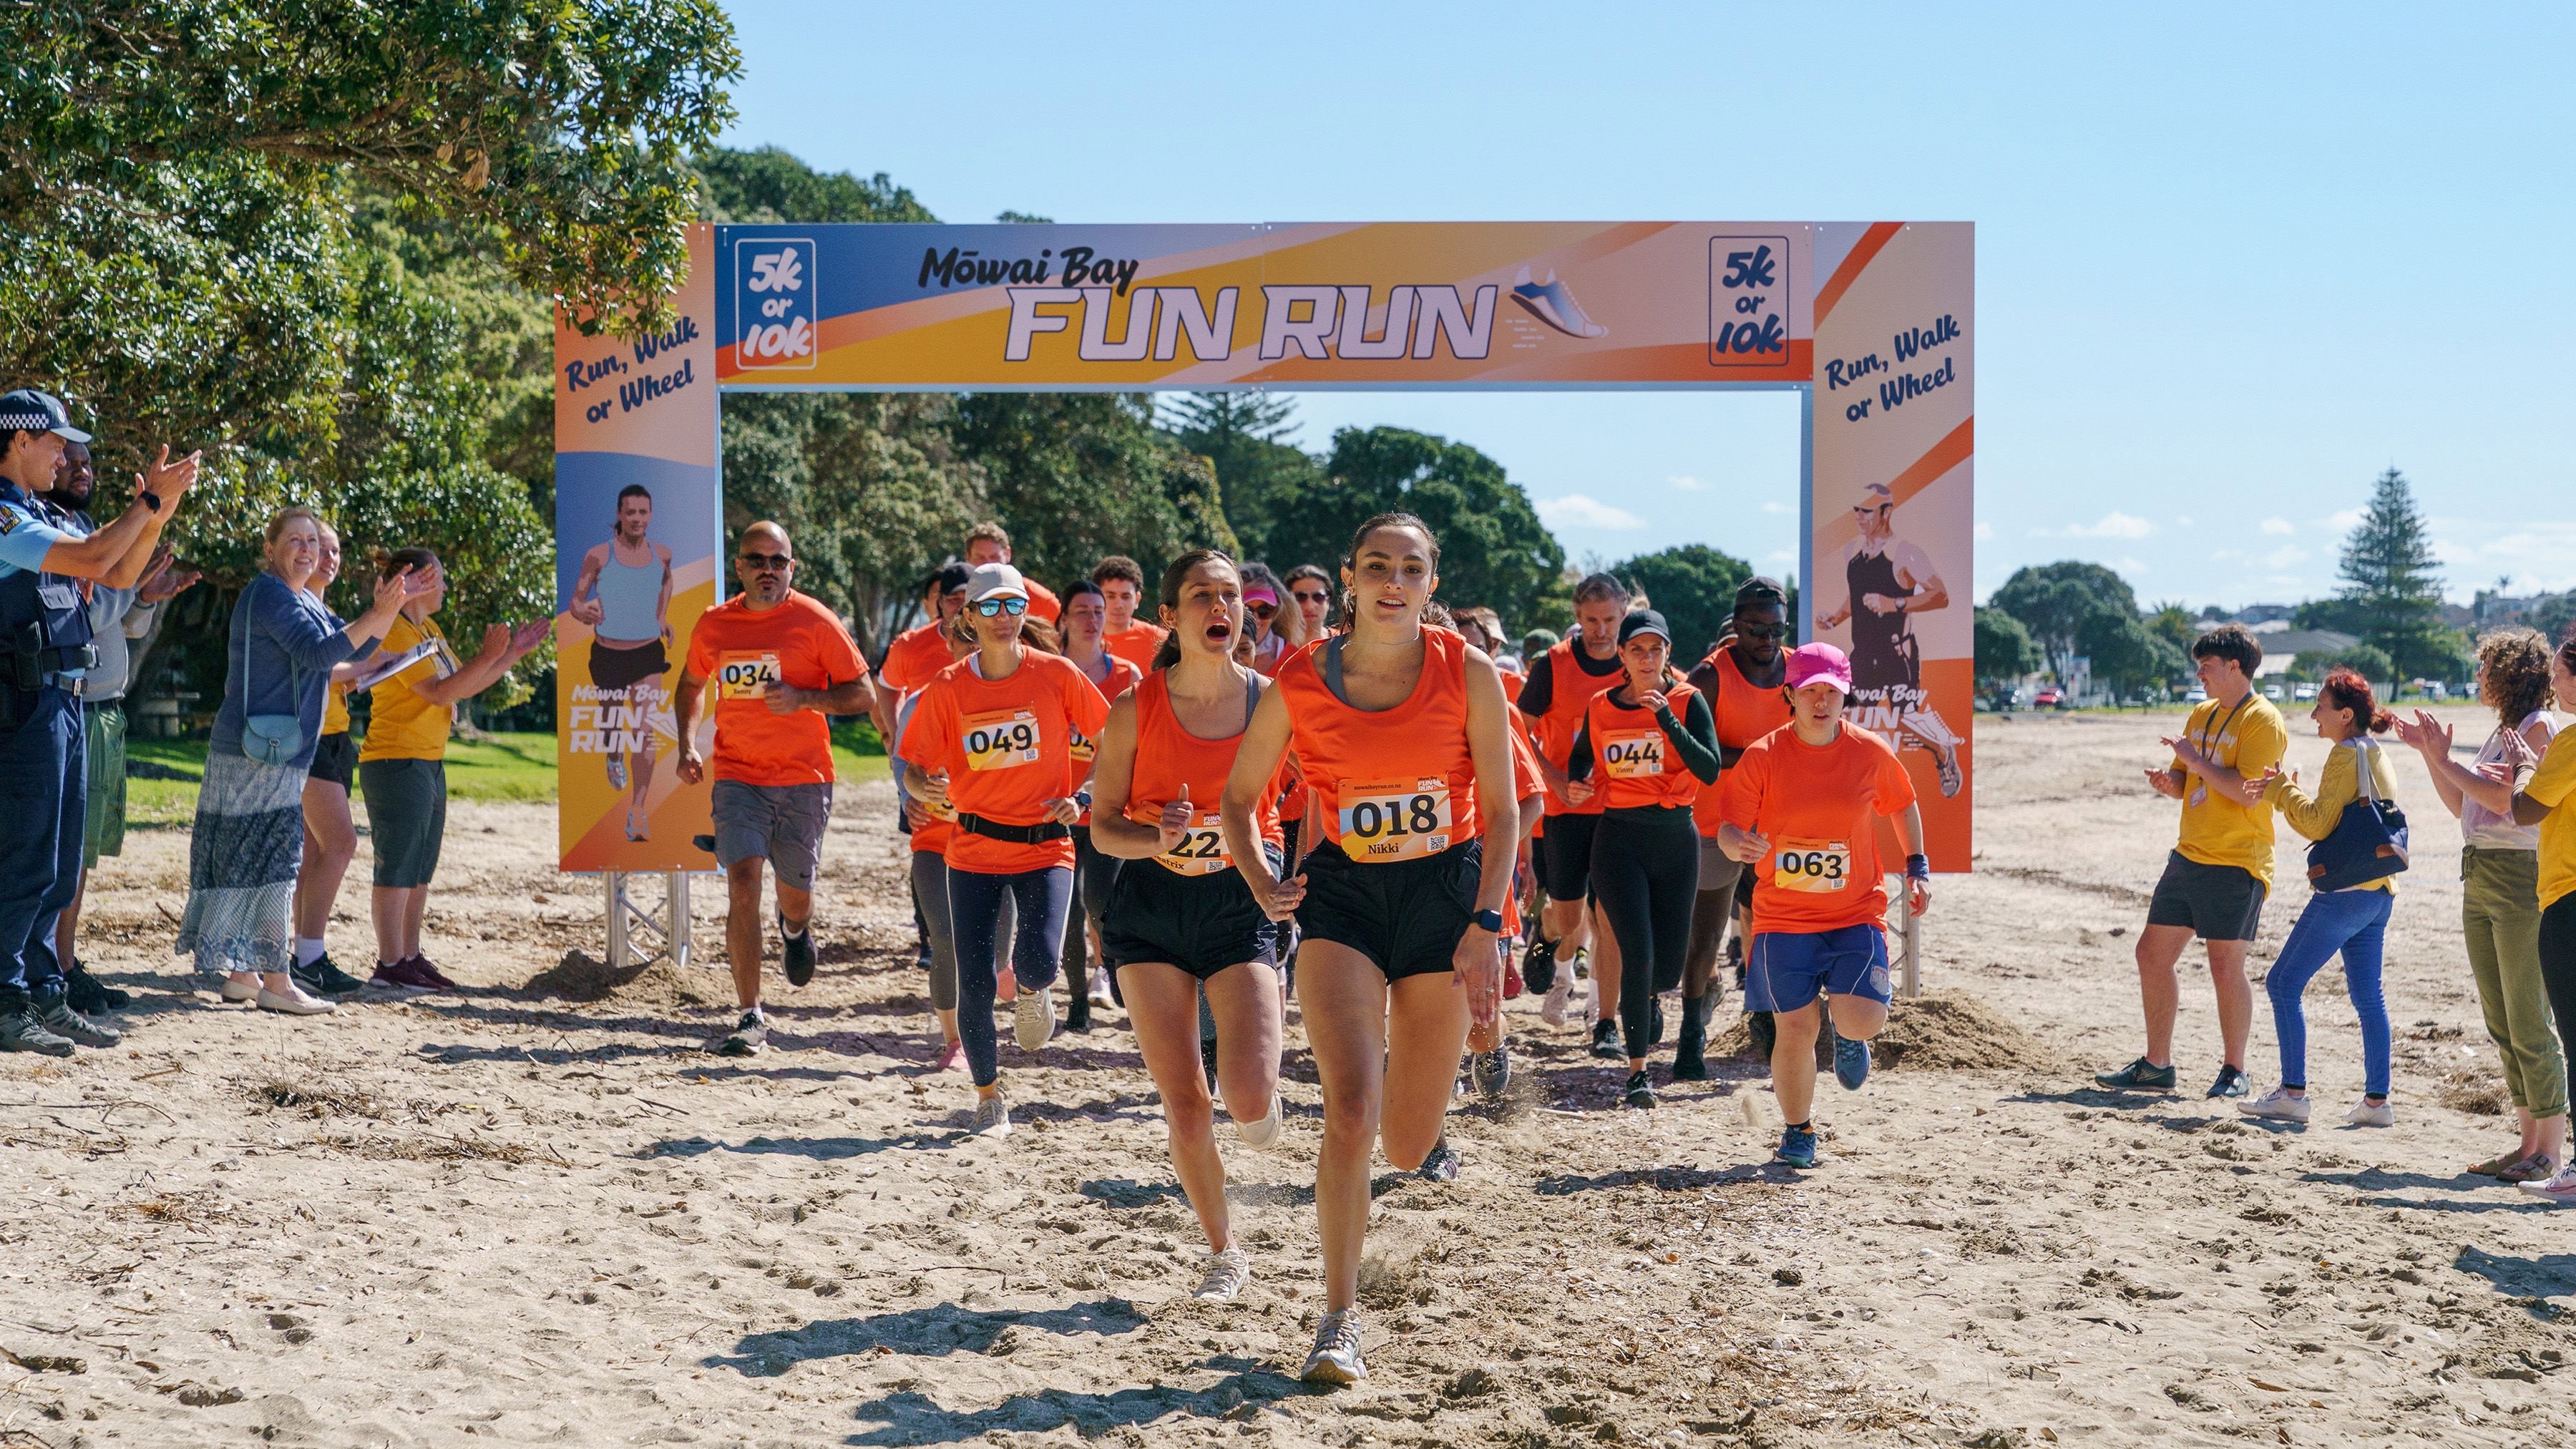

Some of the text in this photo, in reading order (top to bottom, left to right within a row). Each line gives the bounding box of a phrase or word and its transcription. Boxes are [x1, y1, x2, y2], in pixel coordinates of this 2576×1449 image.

[748, 247, 802, 293] 5k
[917, 246, 1139, 297] Mōwai Bay
[1722, 245, 1775, 288] 5k
[762, 298, 793, 318] or
[1735, 296, 1765, 314] or
[743, 316, 811, 358] 10k
[1004, 285, 1498, 361] FUN RUN
[1716, 313, 1784, 354] 10k
[1825, 314, 1961, 390] Run, Walk
[565, 356, 628, 392] Run,
[586, 358, 694, 423] or Wheel
[1846, 357, 1956, 421] or Wheel
[726, 664, 774, 686] 034
[572, 683, 670, 706] Mōwai Bay
[1852, 684, 1928, 706] wai Bay
[570, 706, 644, 728] FUN
[570, 730, 645, 753] RUN
[970, 724, 1033, 754] 049
[1608, 742, 1659, 764] 044
[1352, 794, 1438, 838] 018
[1169, 831, 1221, 858] 22
[1368, 843, 1400, 854] Nikki
[1154, 855, 1184, 870] eatrix
[1782, 852, 1843, 879] 063
